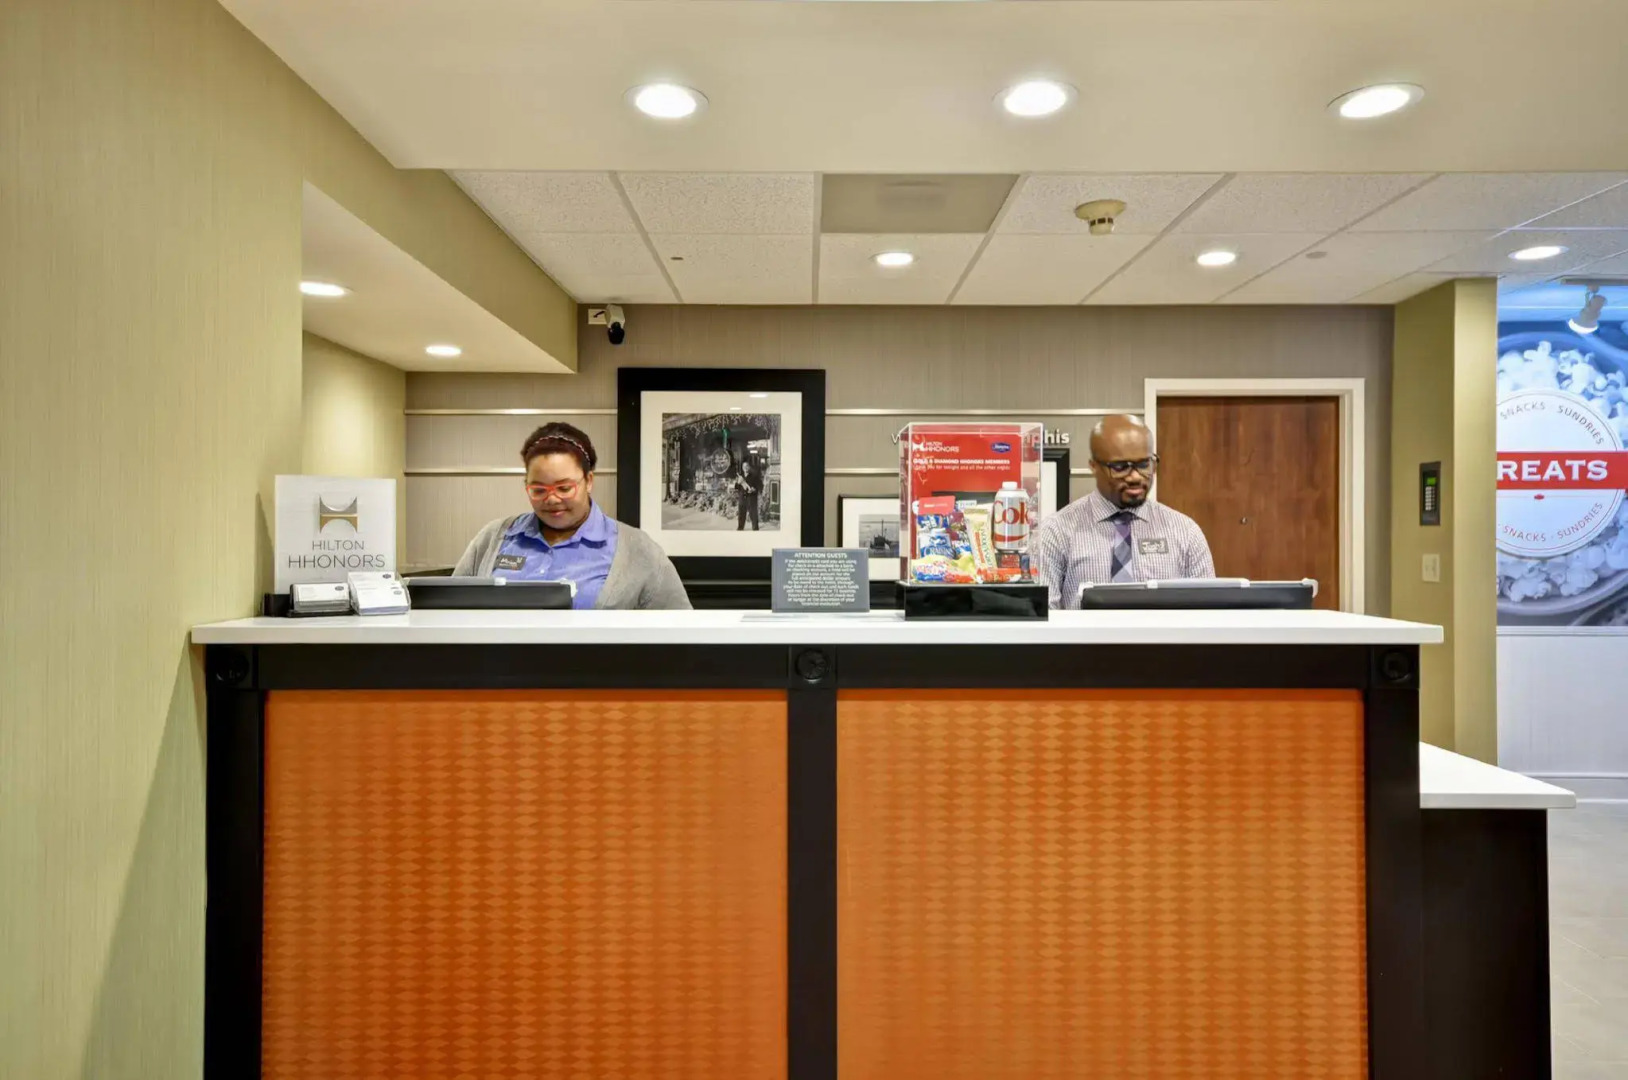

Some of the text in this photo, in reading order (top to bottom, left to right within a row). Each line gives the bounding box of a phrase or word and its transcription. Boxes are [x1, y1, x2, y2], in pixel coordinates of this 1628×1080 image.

[1500, 401, 1605, 446] SNACKS SUNDRIES
[1503, 502, 1604, 542] SNACKS SUNDRIES
[311, 540, 365, 551] HILTON
[288, 554, 386, 569] HHONORS
